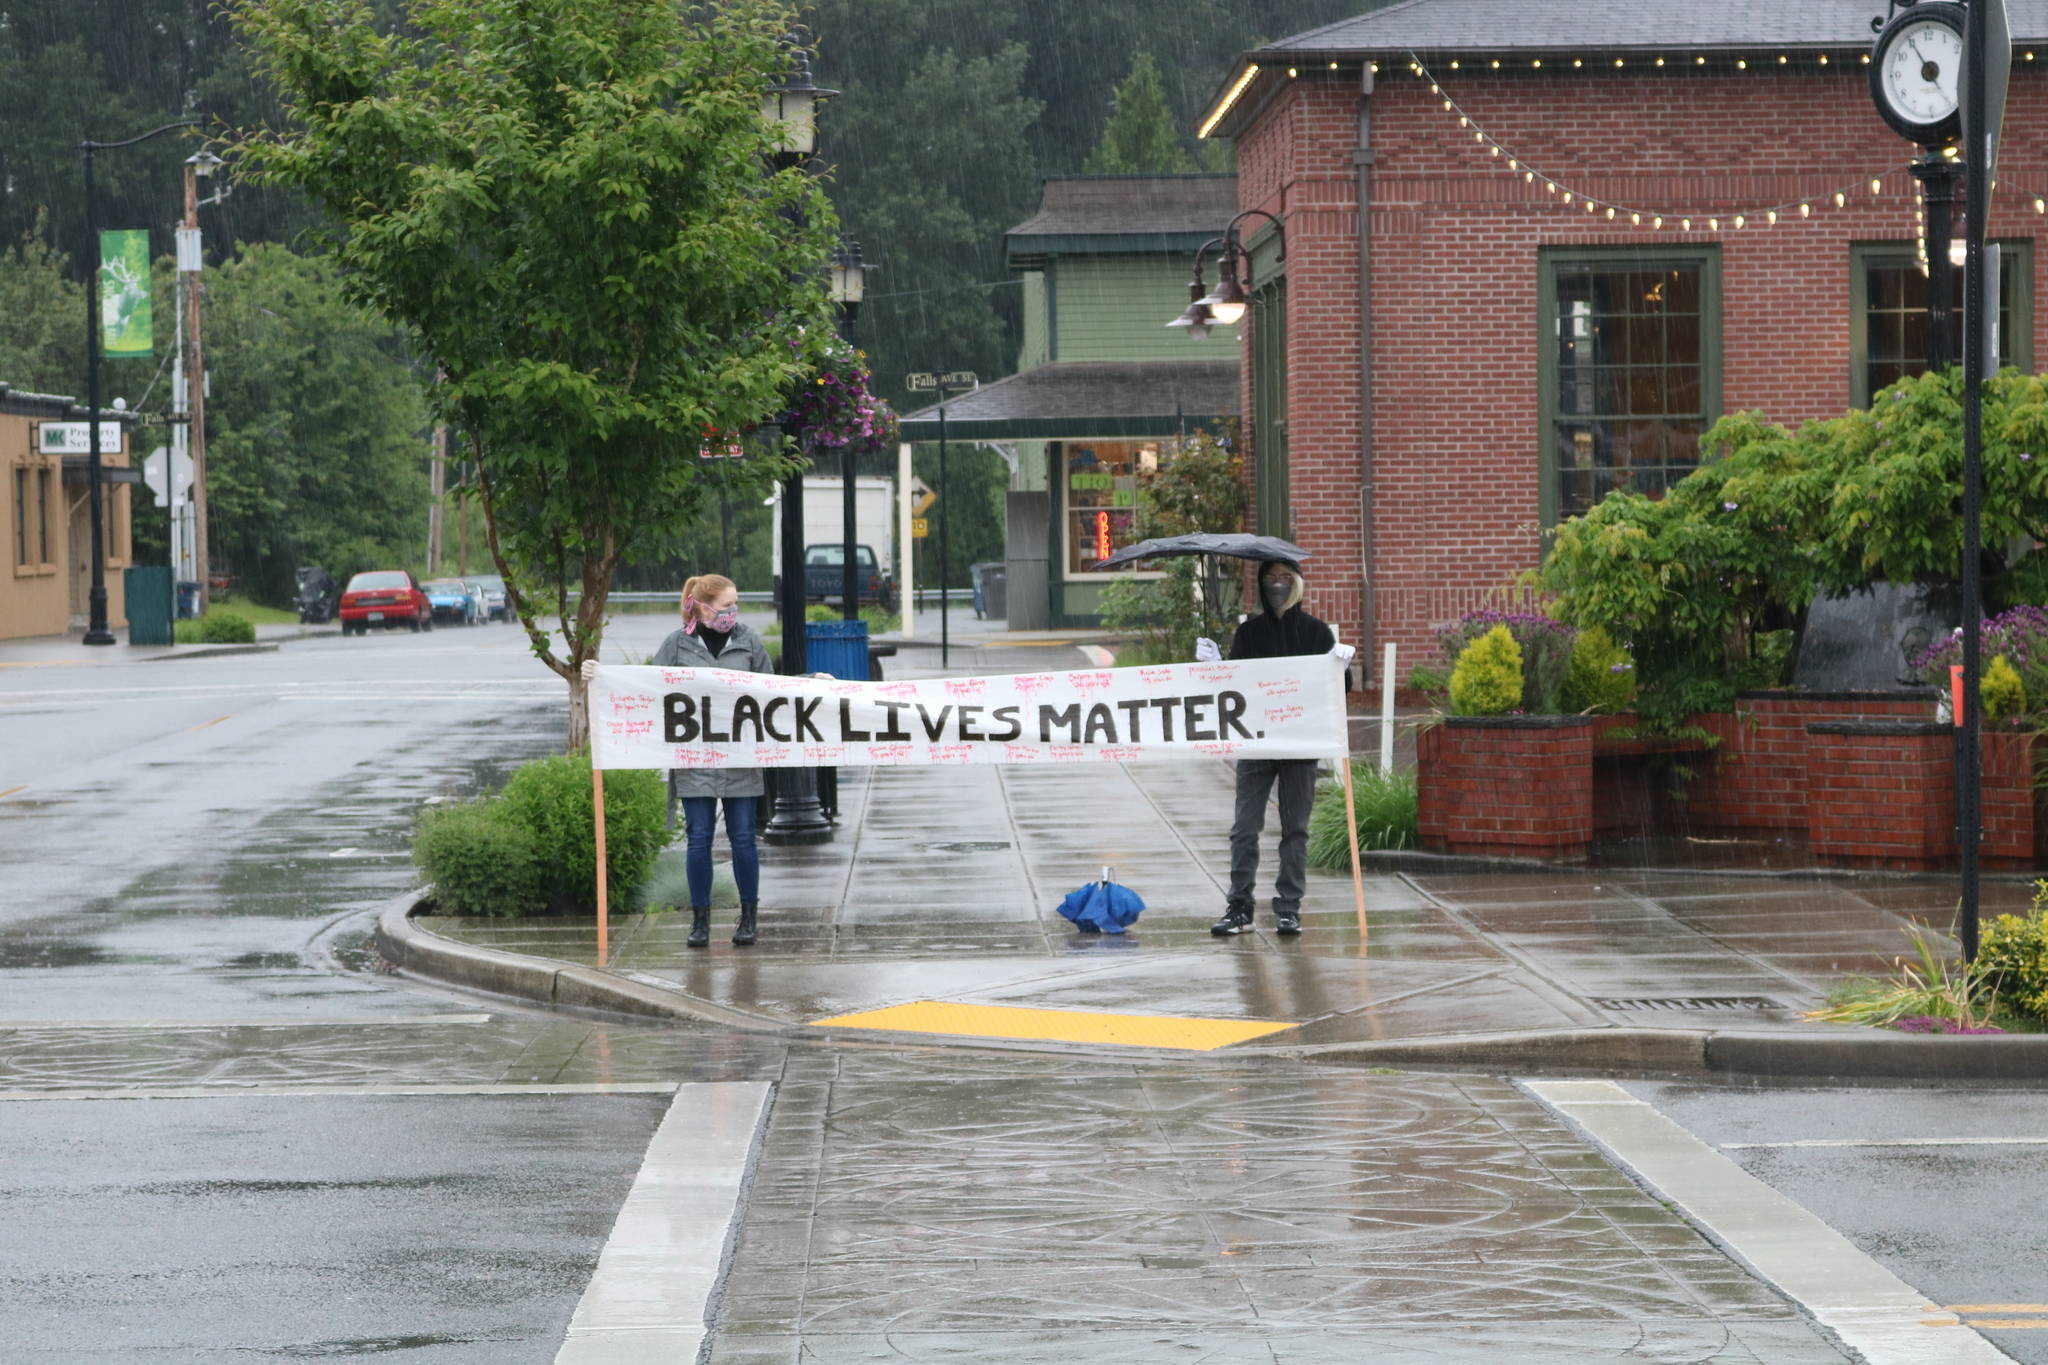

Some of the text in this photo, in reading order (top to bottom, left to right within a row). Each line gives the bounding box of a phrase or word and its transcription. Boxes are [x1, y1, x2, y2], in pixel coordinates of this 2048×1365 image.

[1924, 31, 1933, 41] 12
[1898, 52, 1908, 62] 10
[912, 374, 938, 390] Falls
[70, 428, 115, 439] Prorty
[70, 440, 116, 448] Serces
[1098, 511, 1109, 560] OPEN
[663, 690, 1265, 743] BLACK LIVES MATTER.
